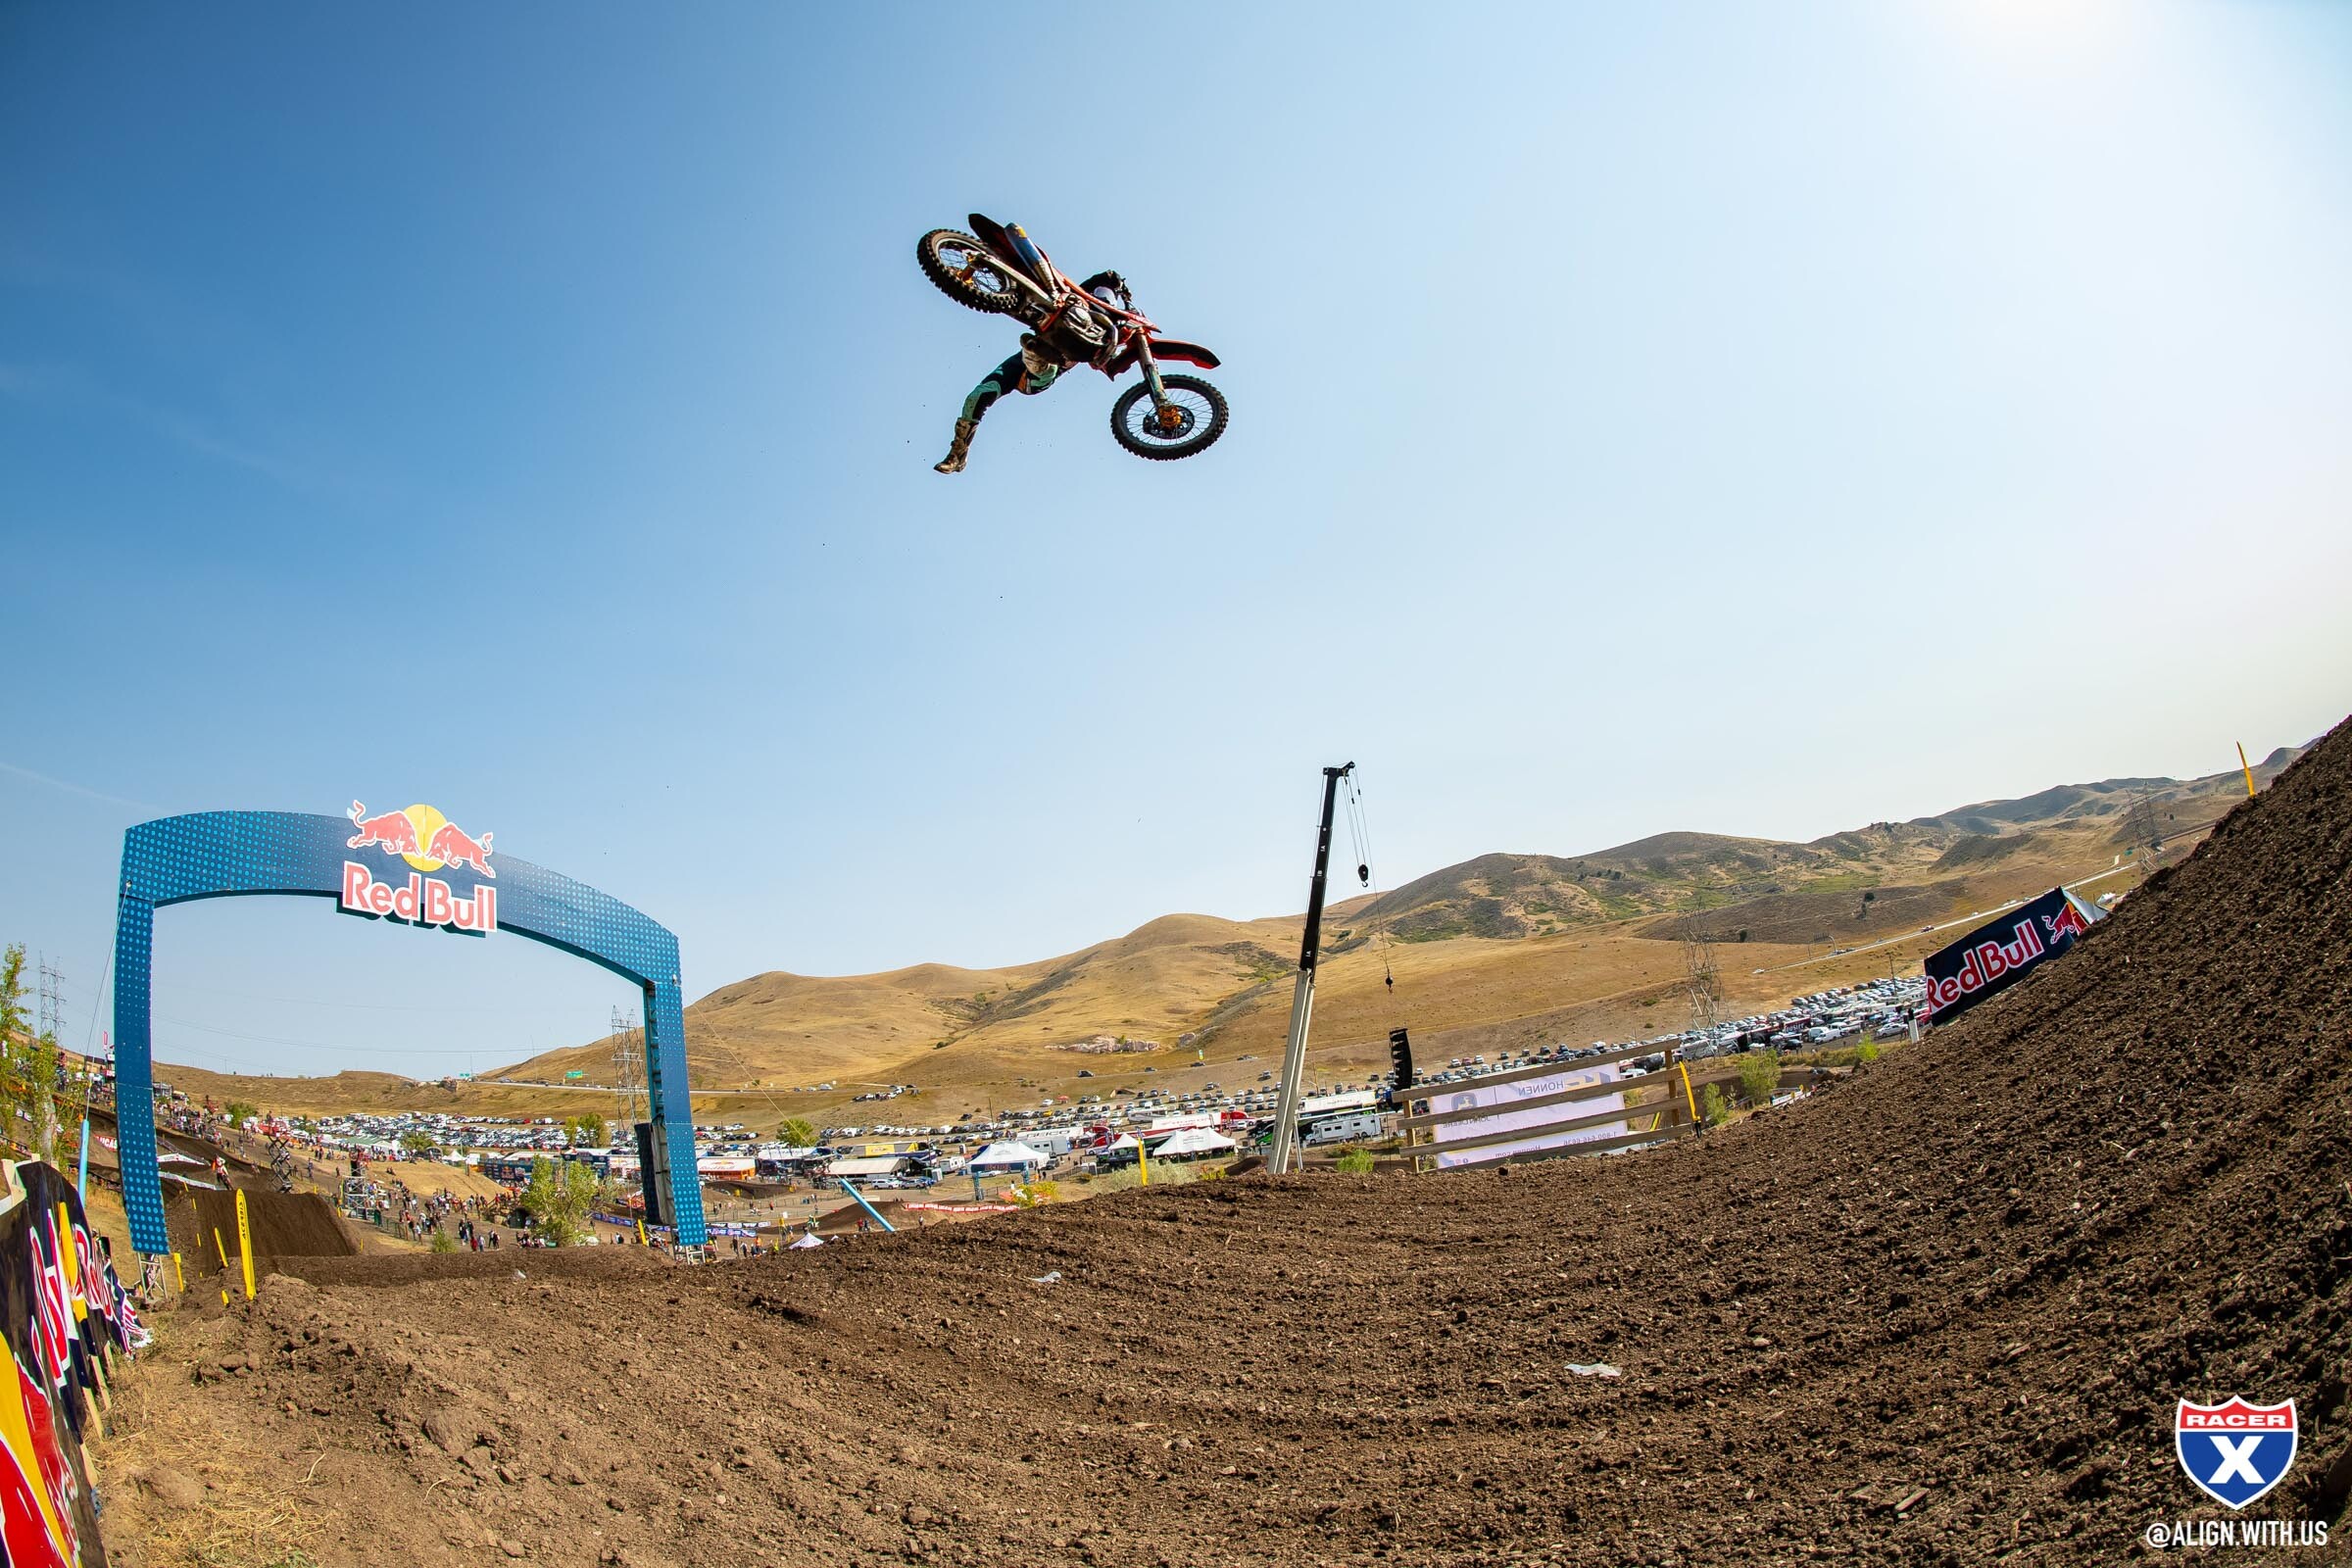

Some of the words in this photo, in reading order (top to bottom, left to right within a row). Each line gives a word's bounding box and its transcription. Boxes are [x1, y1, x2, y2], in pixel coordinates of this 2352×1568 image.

[344, 860, 421, 921] Red
[424, 877, 498, 933] Bull
[1927, 948, 1985, 1014] Red
[1976, 917, 2045, 983] Bull
